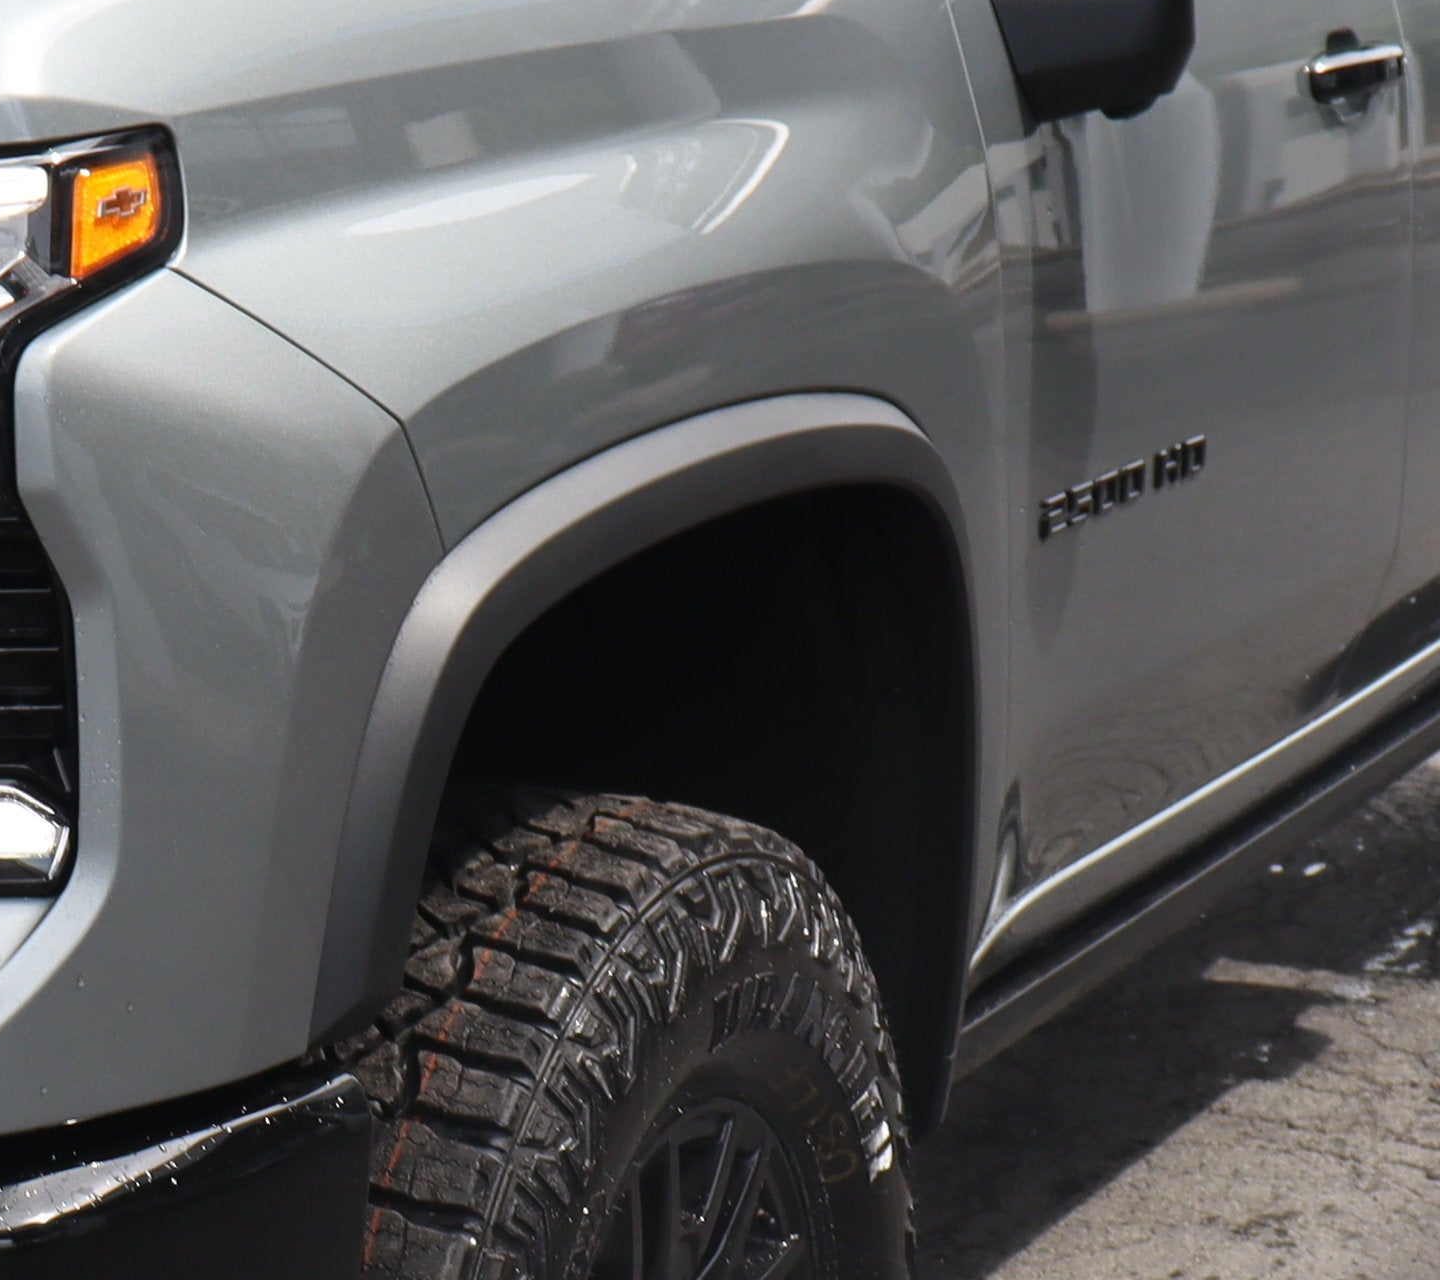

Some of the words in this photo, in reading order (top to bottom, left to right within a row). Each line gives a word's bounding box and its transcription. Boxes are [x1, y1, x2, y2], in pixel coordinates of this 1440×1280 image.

[1039, 458, 1146, 543] 2500
[1153, 433, 1207, 491] HD
[708, 970, 895, 1186] WRANGLER
